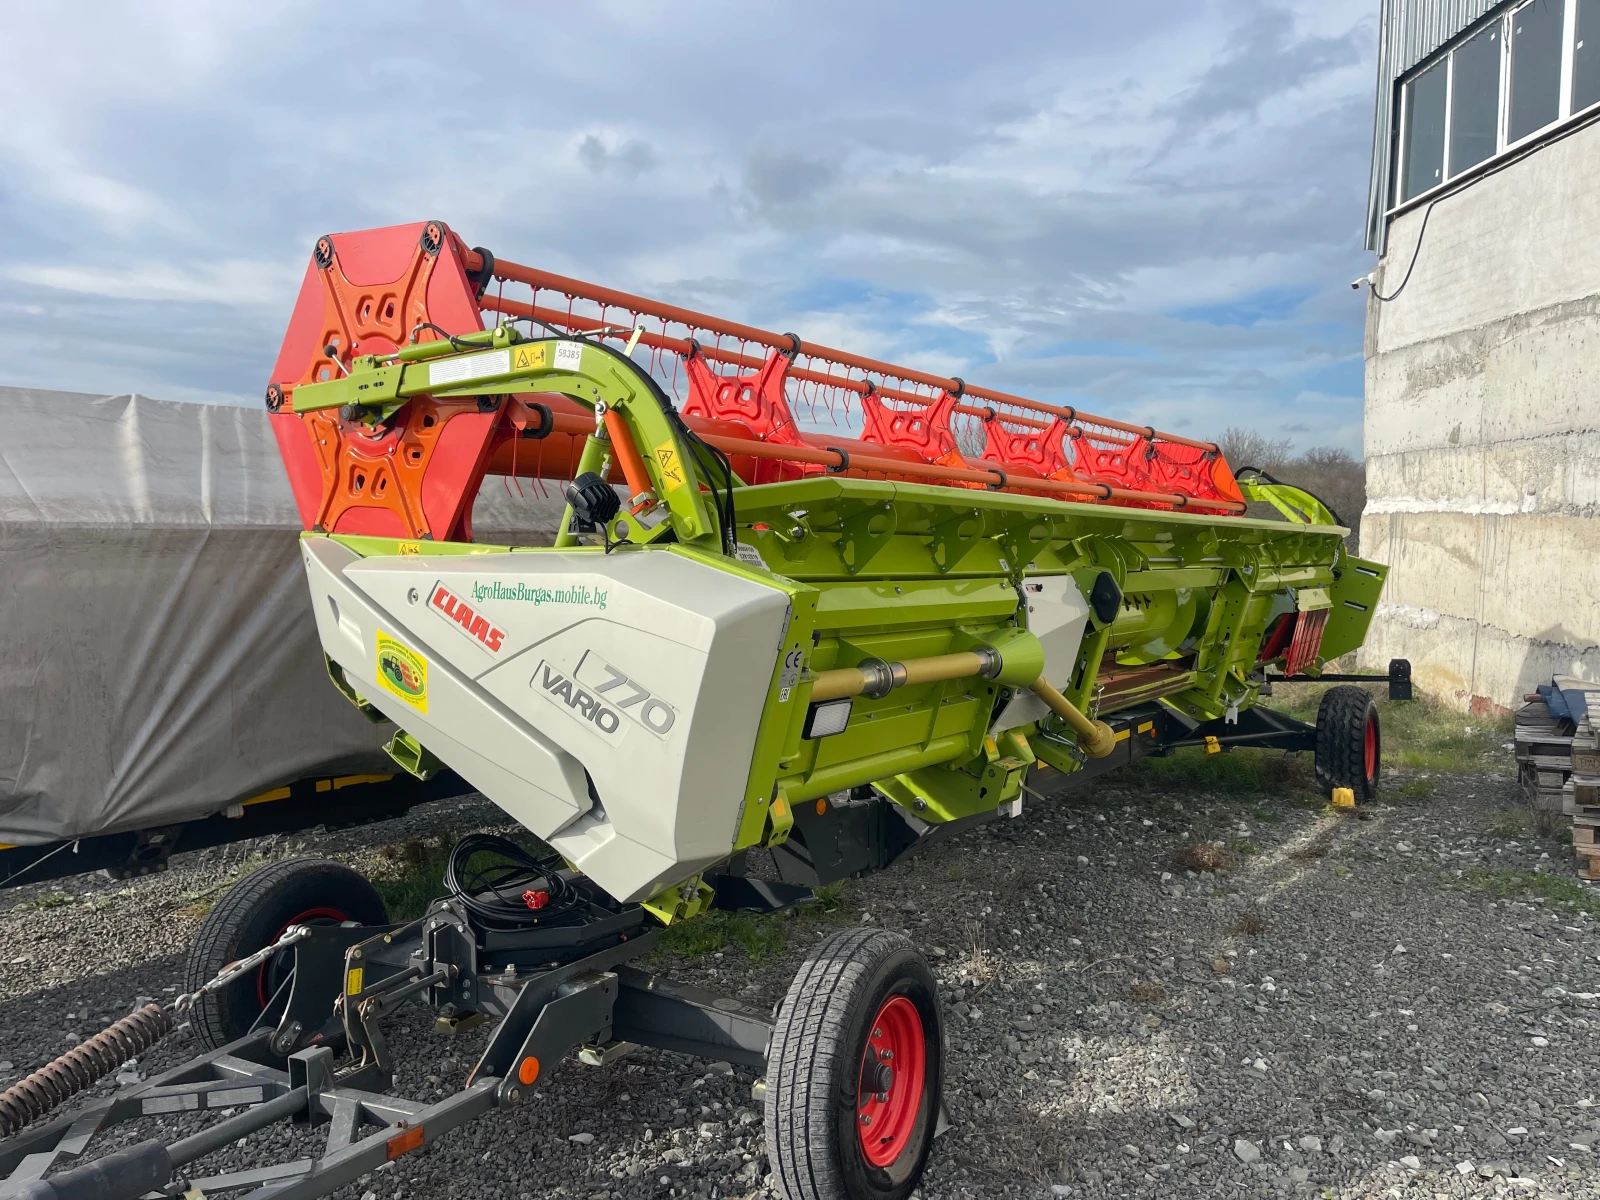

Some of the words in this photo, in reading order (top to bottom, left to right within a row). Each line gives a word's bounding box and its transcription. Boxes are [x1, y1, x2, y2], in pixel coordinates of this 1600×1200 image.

[432, 586, 505, 653] CLAAS
[471, 580, 608, 610] AgroHausBurgas.mobile.bg
[542, 664, 620, 734] VARIO
[593, 663, 676, 735] 770
